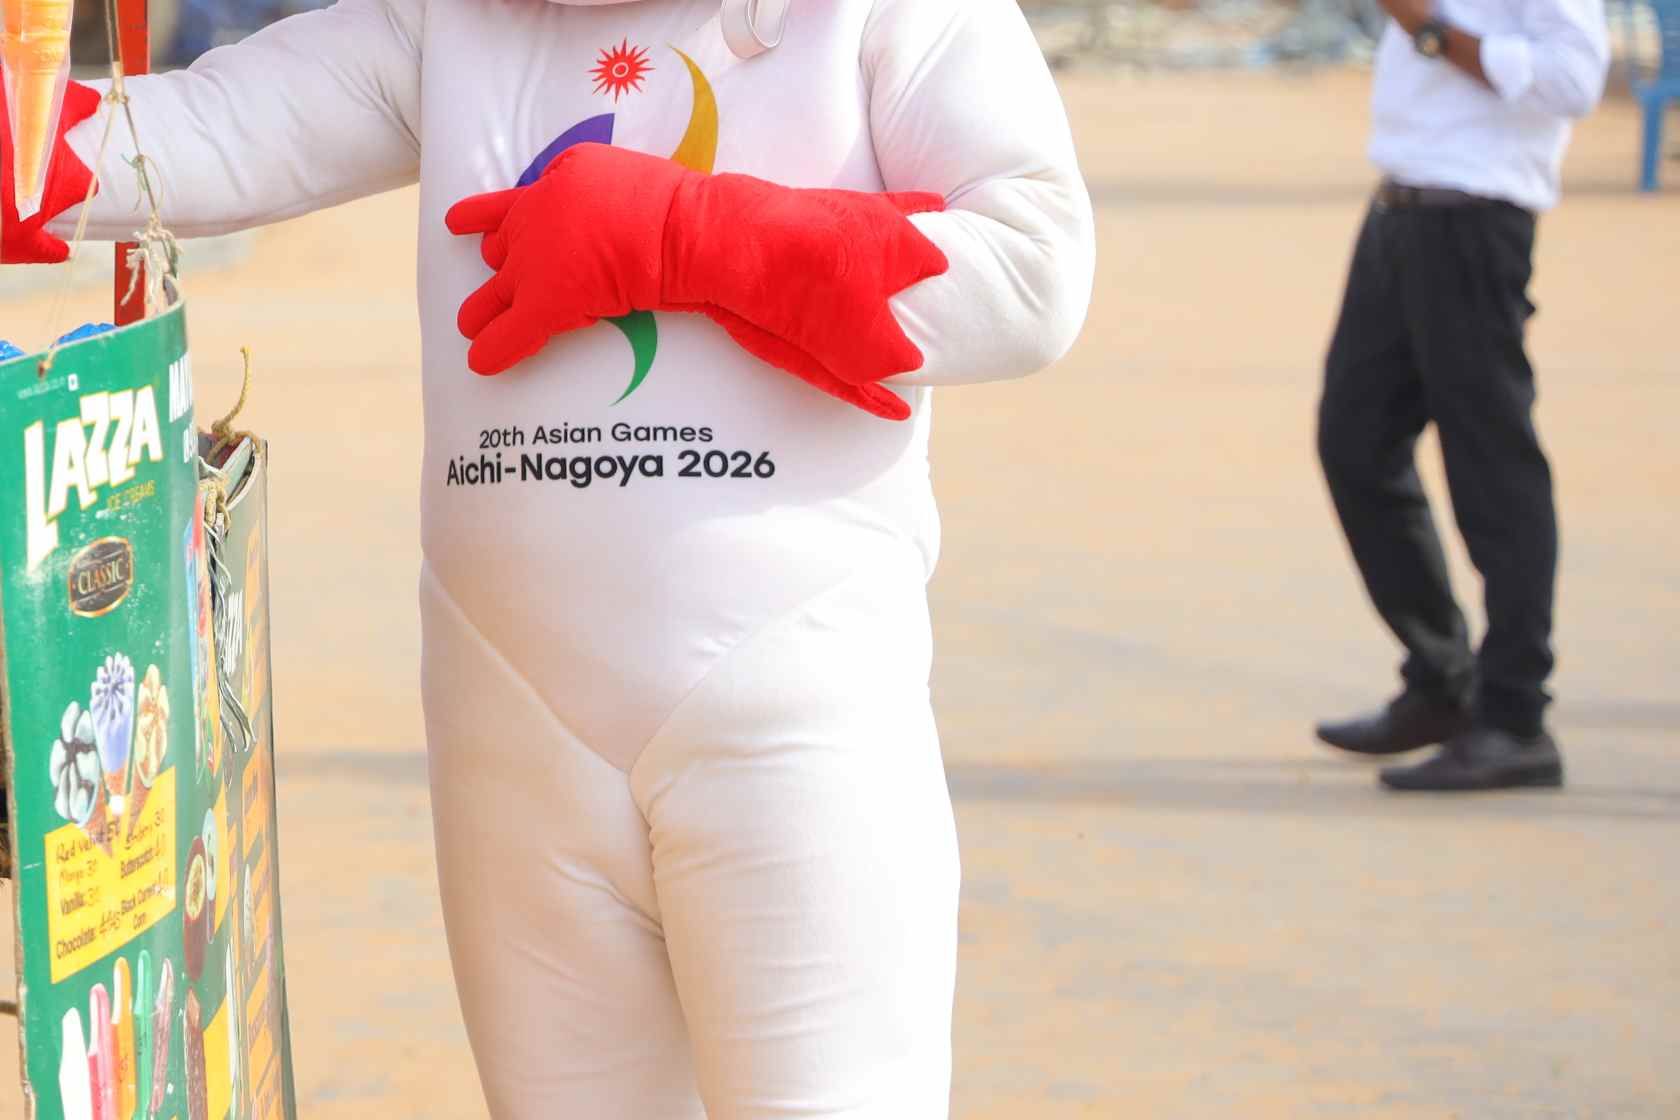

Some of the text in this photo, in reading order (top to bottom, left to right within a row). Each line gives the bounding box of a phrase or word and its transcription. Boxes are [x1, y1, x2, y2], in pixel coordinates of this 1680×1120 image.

[479, 422, 714, 449] 20th Asian Games
[23, 385, 164, 579] LAZZA
[446, 449, 776, 489] Aichi-Nagoya 2026
[78, 561, 124, 593] CLASSIC
